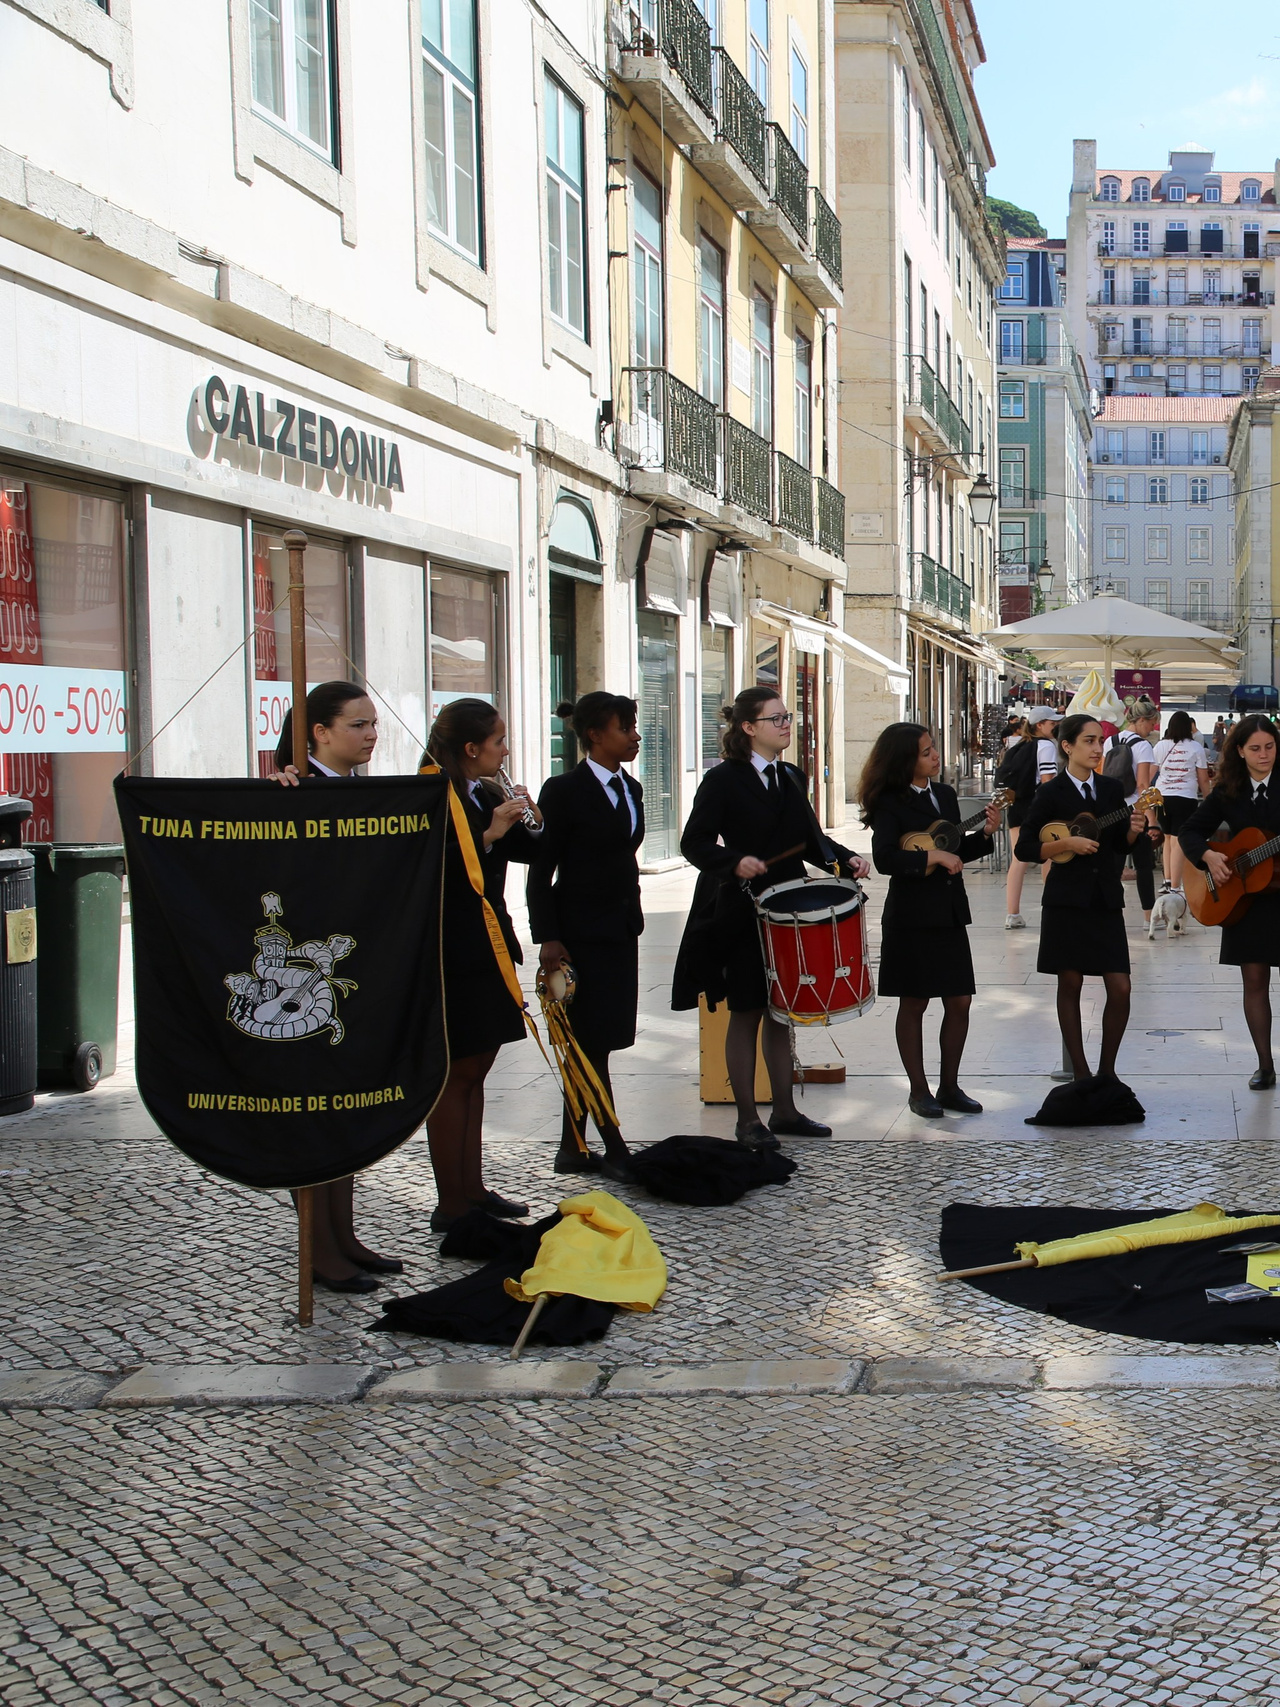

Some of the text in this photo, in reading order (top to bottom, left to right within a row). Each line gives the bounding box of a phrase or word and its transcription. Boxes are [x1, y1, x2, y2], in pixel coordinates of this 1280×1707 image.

[203, 375, 405, 494] CALZEDONIA
[54, 686, 127, 735] -50%
[139, 813, 430, 840] TUNA FEMININA DE MEDICINA
[188, 1085, 405, 1113] UNIVERSIDADE DE COIMBRA
